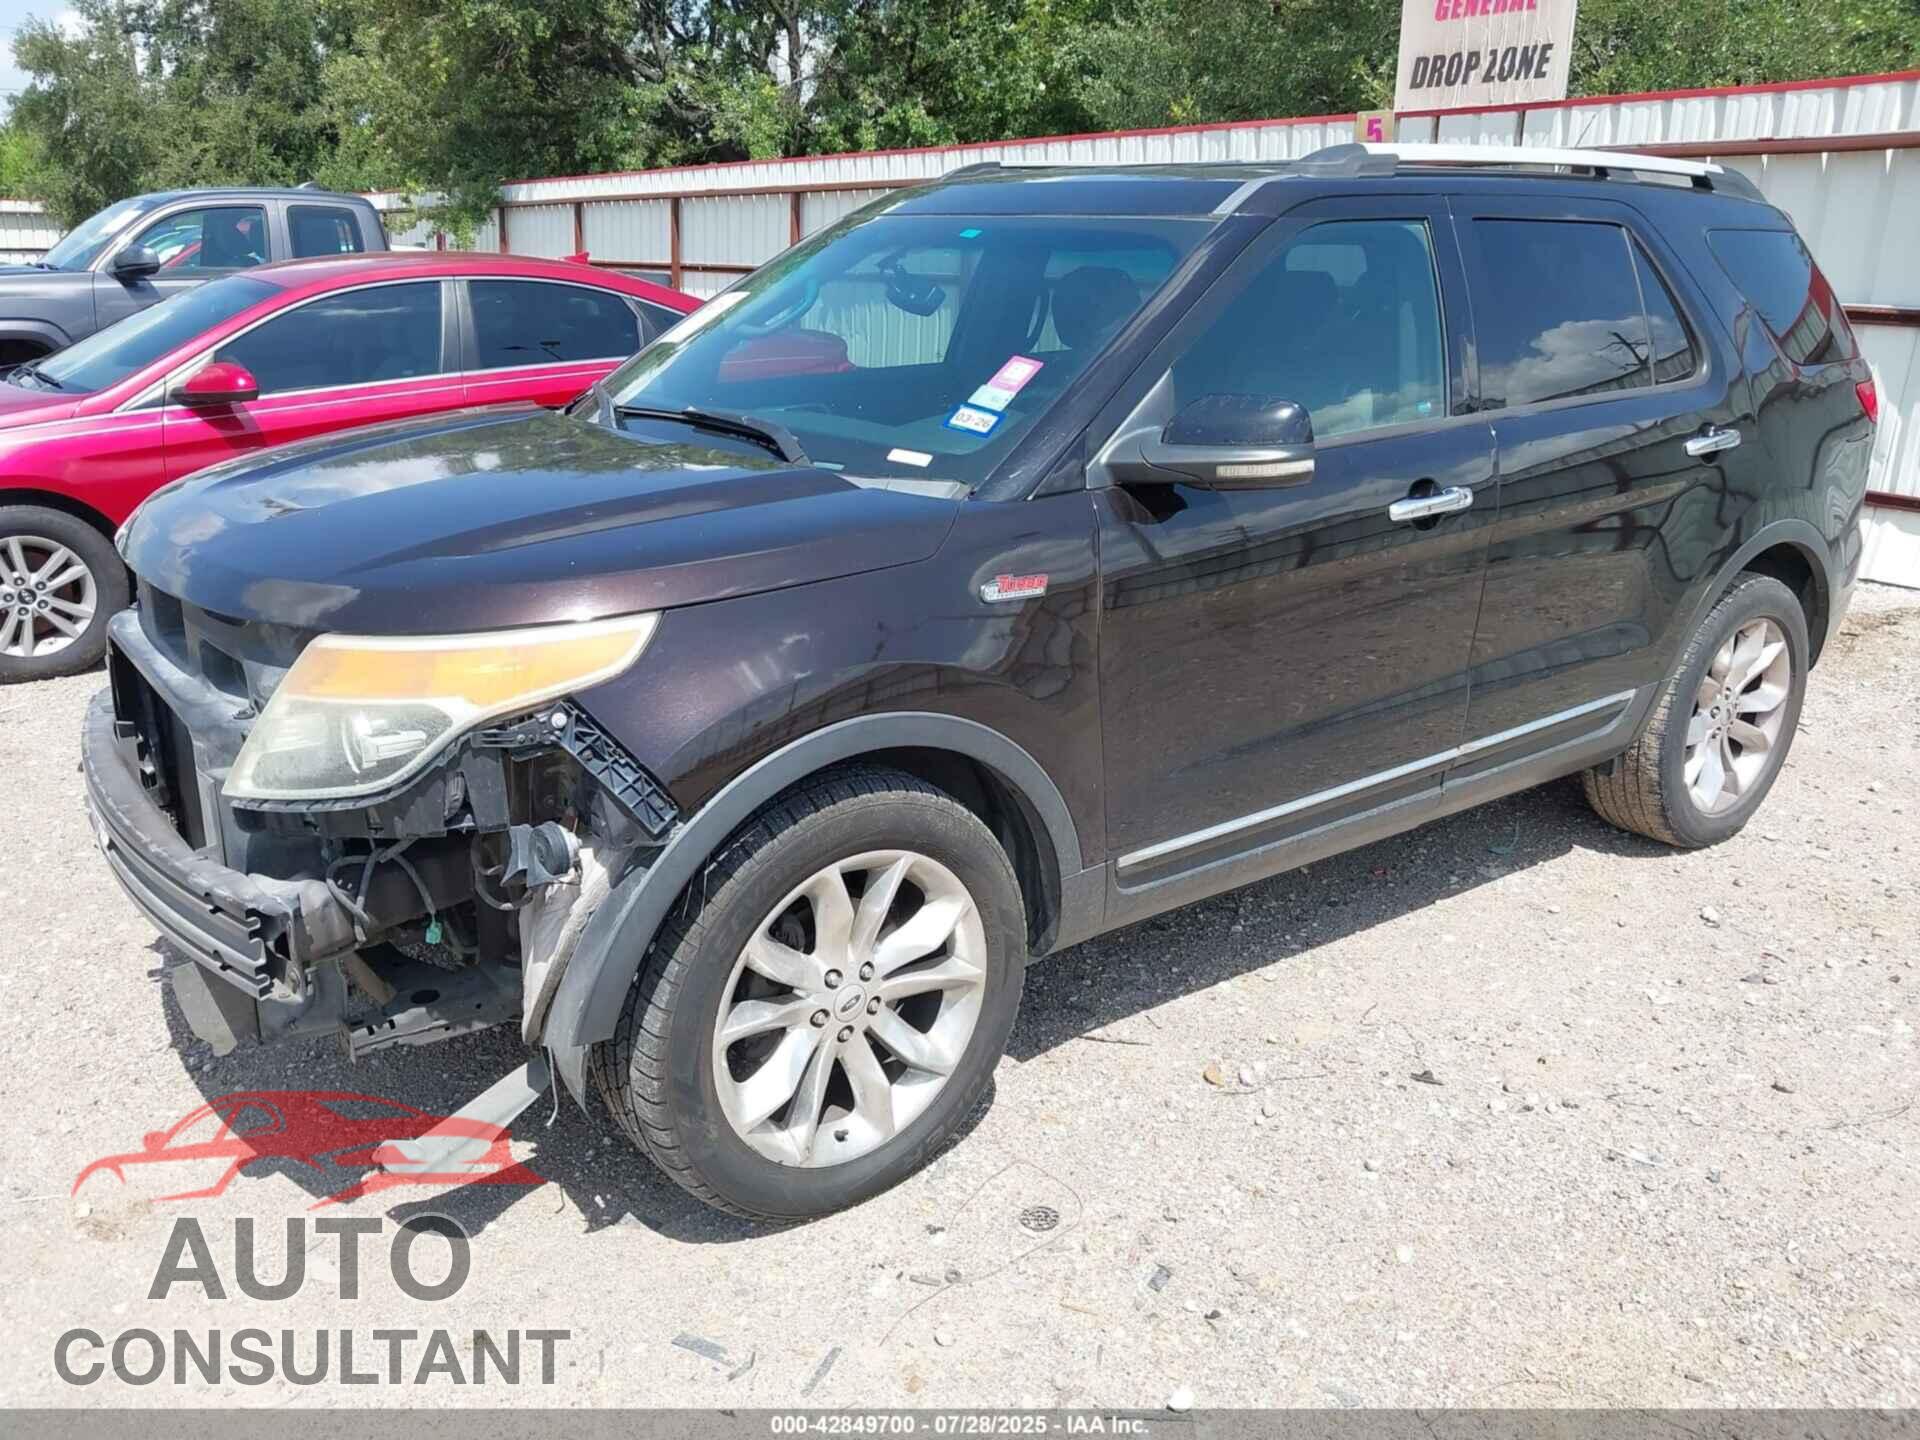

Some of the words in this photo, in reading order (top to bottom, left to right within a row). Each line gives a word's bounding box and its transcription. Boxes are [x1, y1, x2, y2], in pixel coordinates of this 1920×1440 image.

[1409, 51, 1480, 89] DROP
[1481, 43, 1554, 84] ZONE
[1366, 118, 1383, 143] 5
